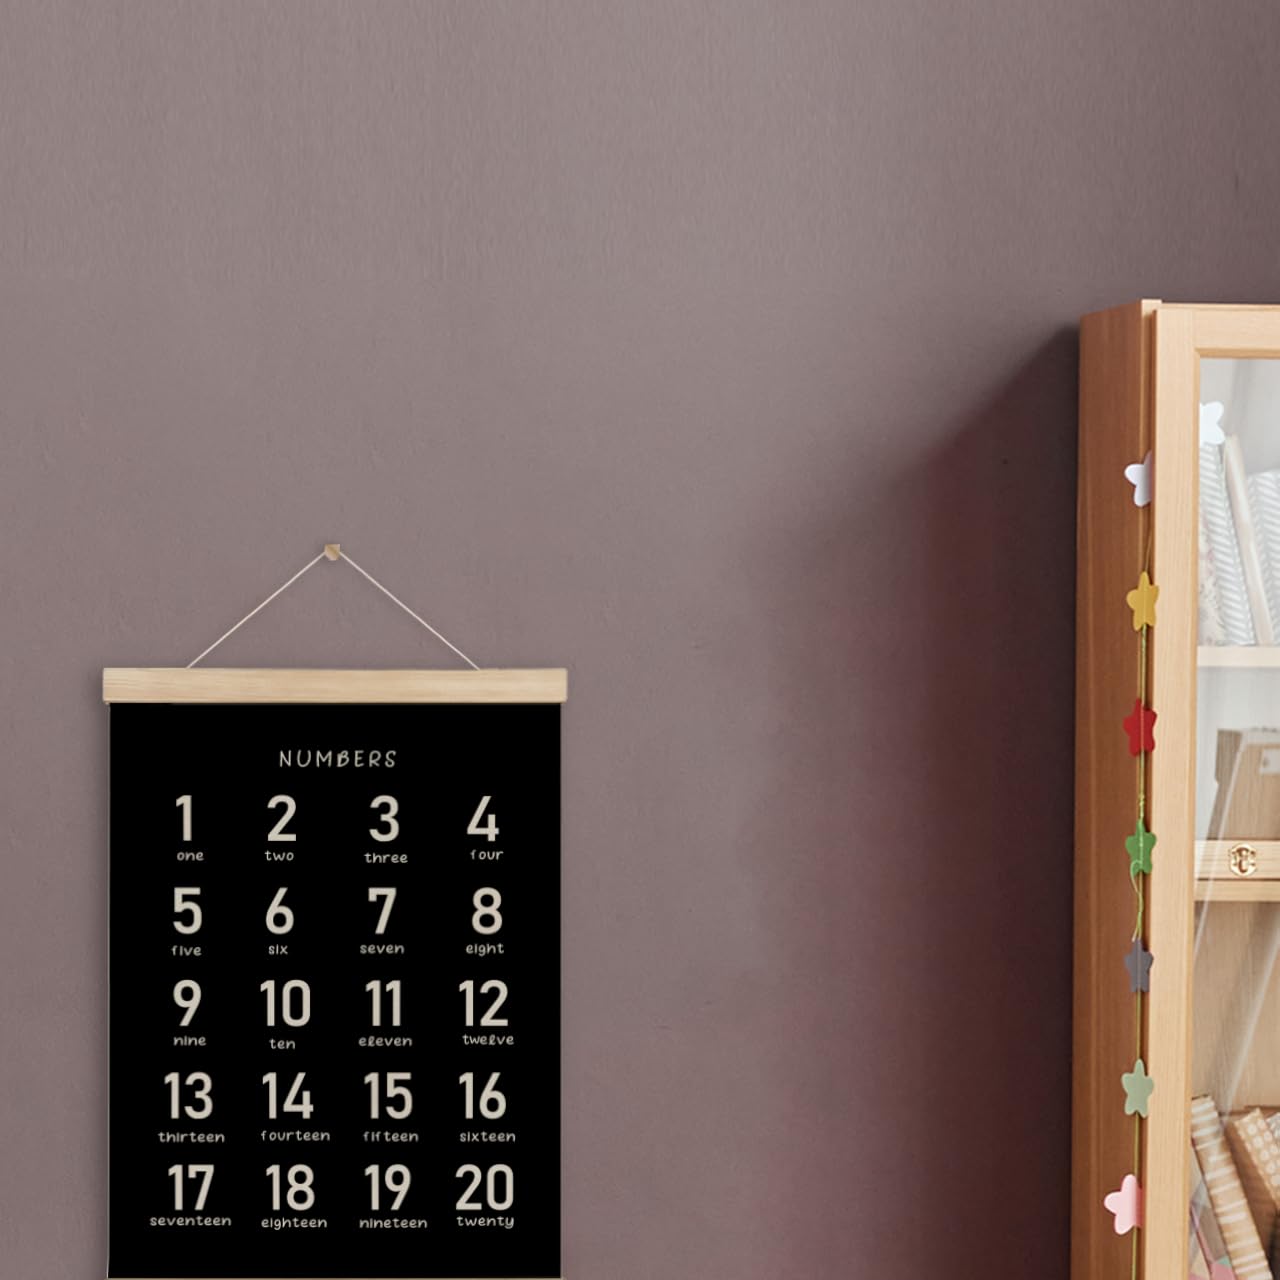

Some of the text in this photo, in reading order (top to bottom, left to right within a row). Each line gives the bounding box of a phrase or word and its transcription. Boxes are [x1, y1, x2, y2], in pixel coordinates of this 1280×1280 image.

[279, 749, 397, 768] NUMBERS
[175, 794, 500, 842] 1 2 3 4
[176, 849, 504, 864] one two three four
[173, 886, 503, 935] 5 6 7 8
[171, 943, 505, 957] five six seven eight
[172, 979, 509, 1028] 9 10 11 12
[173, 1034, 514, 1050] nine ten eleven twelve
[164, 1071, 507, 1120] 13 14 15 16
[157, 1129, 516, 1143] thirteen fourteen fifteen sixteen
[167, 1163, 514, 1211] 17 18 19 20
[149, 1215, 515, 1231] seventeen eighteen nineteen twenty
